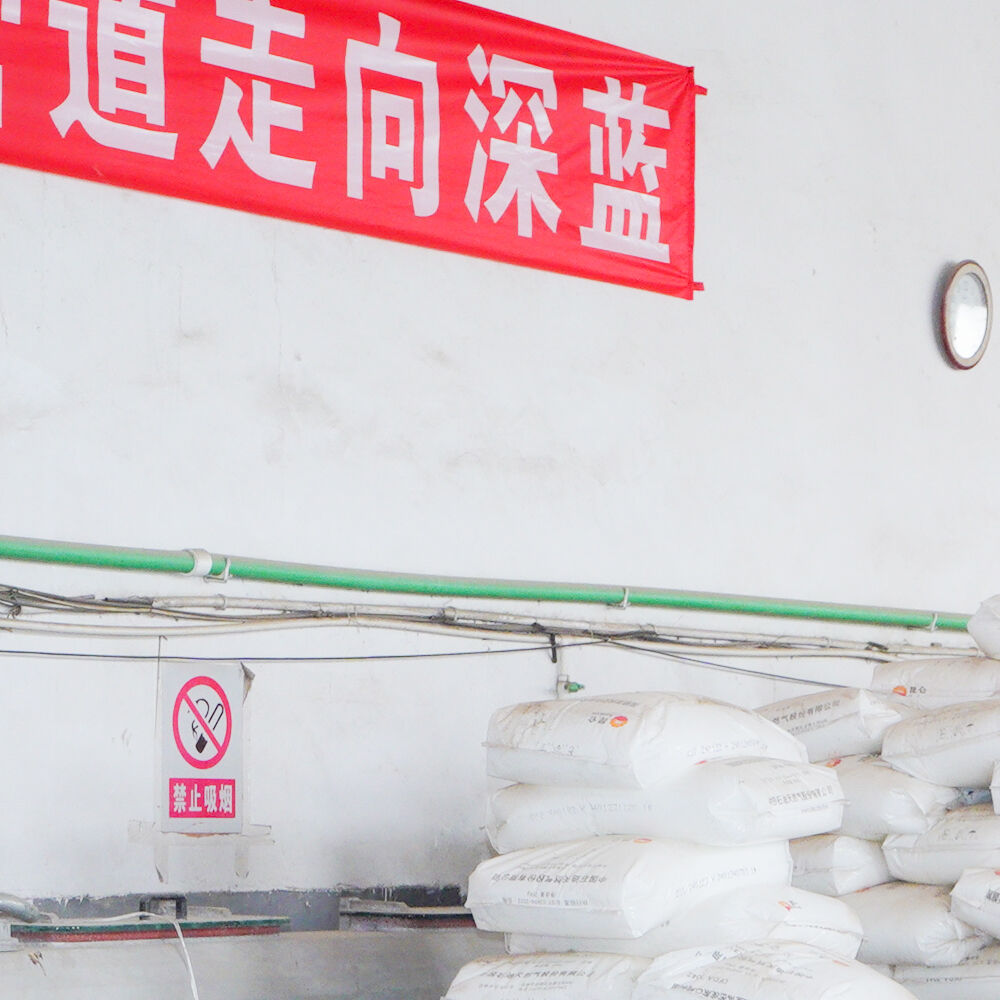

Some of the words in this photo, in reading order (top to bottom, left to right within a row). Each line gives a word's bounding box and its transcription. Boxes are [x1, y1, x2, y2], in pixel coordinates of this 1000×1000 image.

[0, 0, 671, 264] 道走向深蓝
[173, 783, 233, 814] 禁止吸烟
